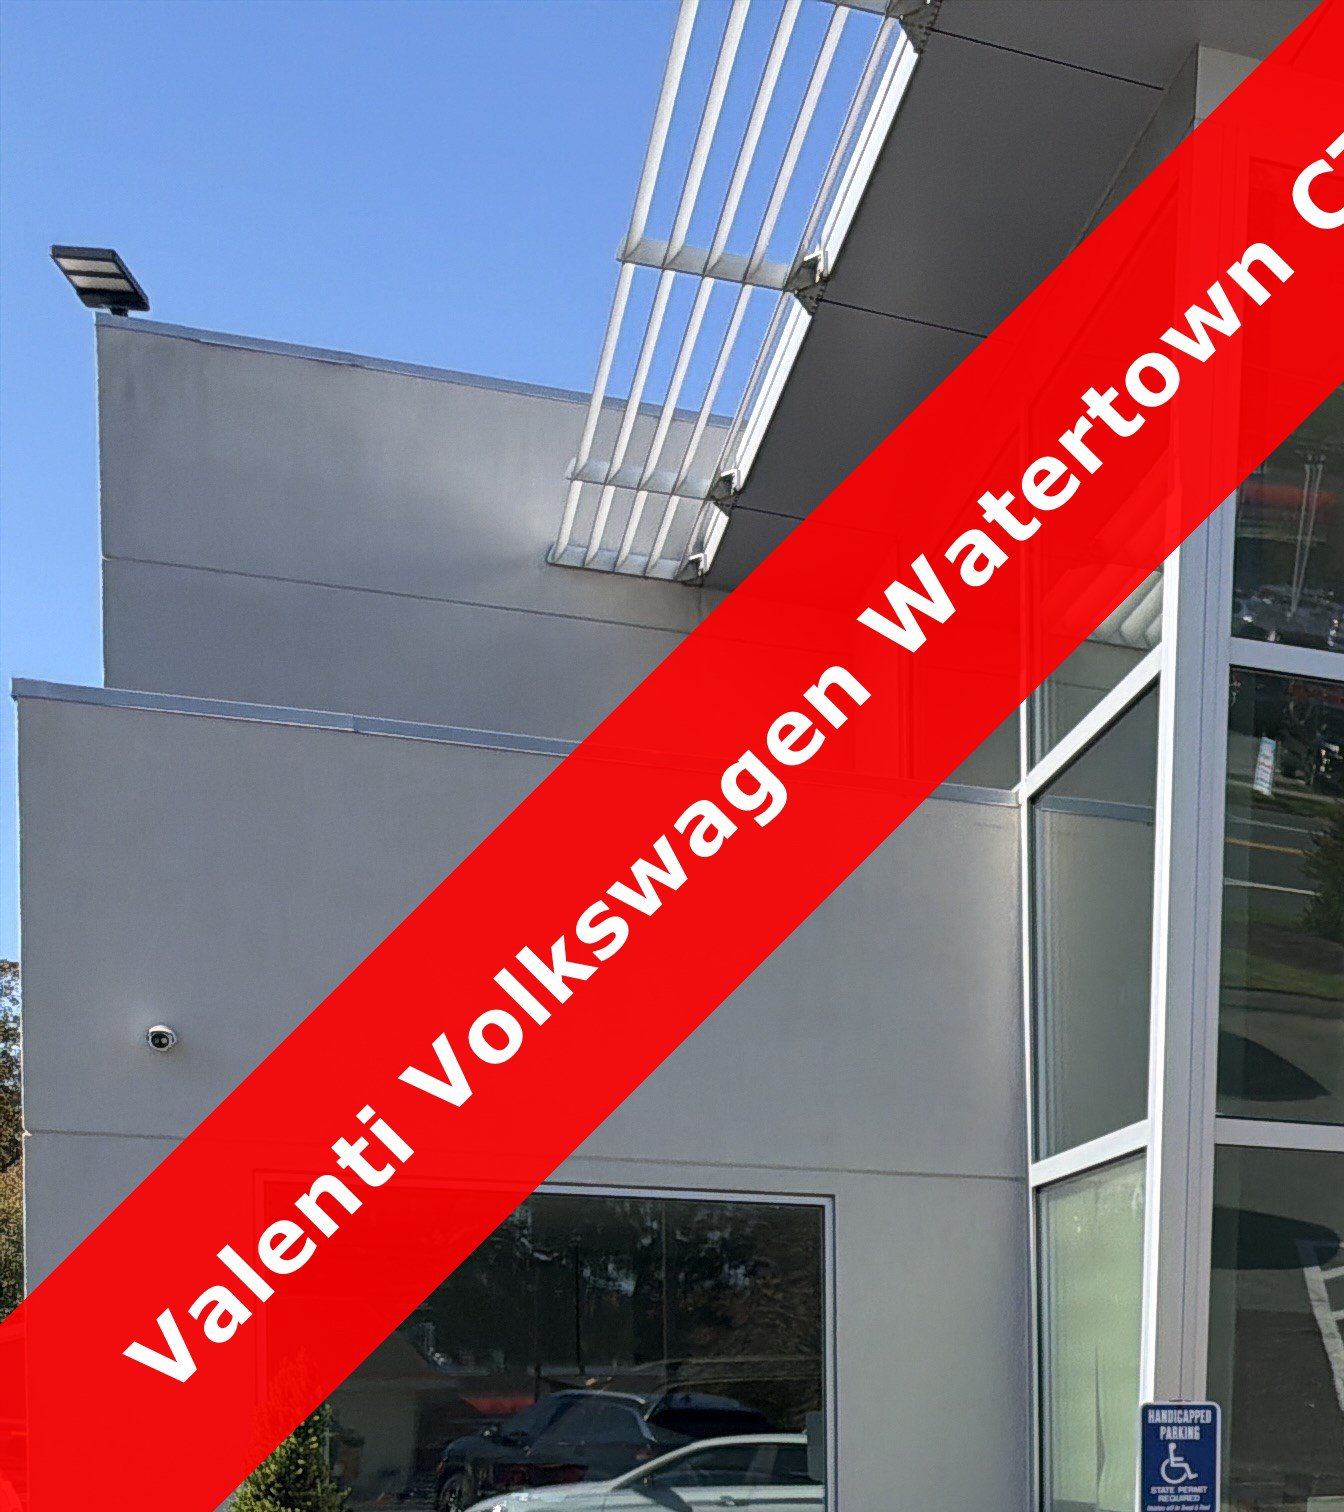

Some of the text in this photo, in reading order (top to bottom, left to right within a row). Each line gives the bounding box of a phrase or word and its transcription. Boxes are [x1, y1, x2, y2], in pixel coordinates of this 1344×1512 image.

[1148, 1409, 1212, 1424] HANDICAPPED
[1159, 1426, 1200, 1440] PARKING
[1150, 1486, 1208, 1494] STATE PERMIT
[1158, 1494, 1200, 1502] REQUIRED
